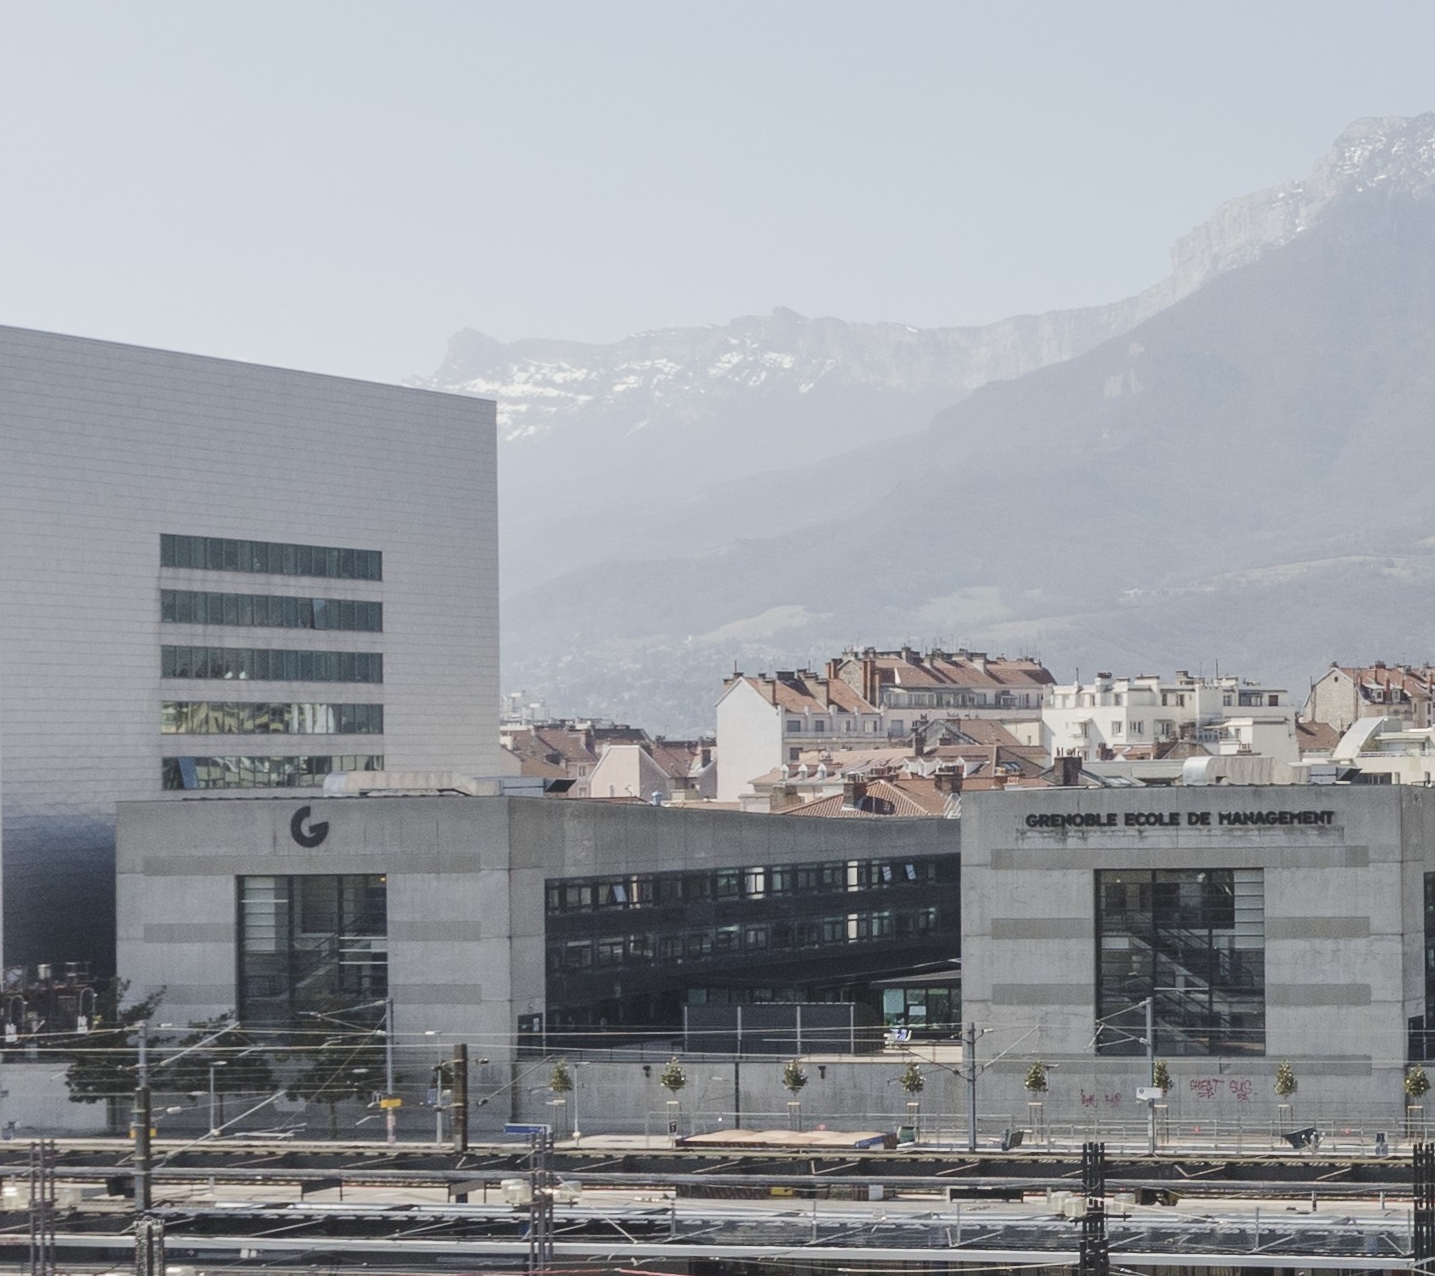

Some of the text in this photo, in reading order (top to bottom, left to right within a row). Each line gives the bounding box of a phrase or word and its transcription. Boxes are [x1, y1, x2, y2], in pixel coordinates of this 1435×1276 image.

[1025, 810, 1335, 828] GRENOBLE ECOLE DE MANAGEMENT
